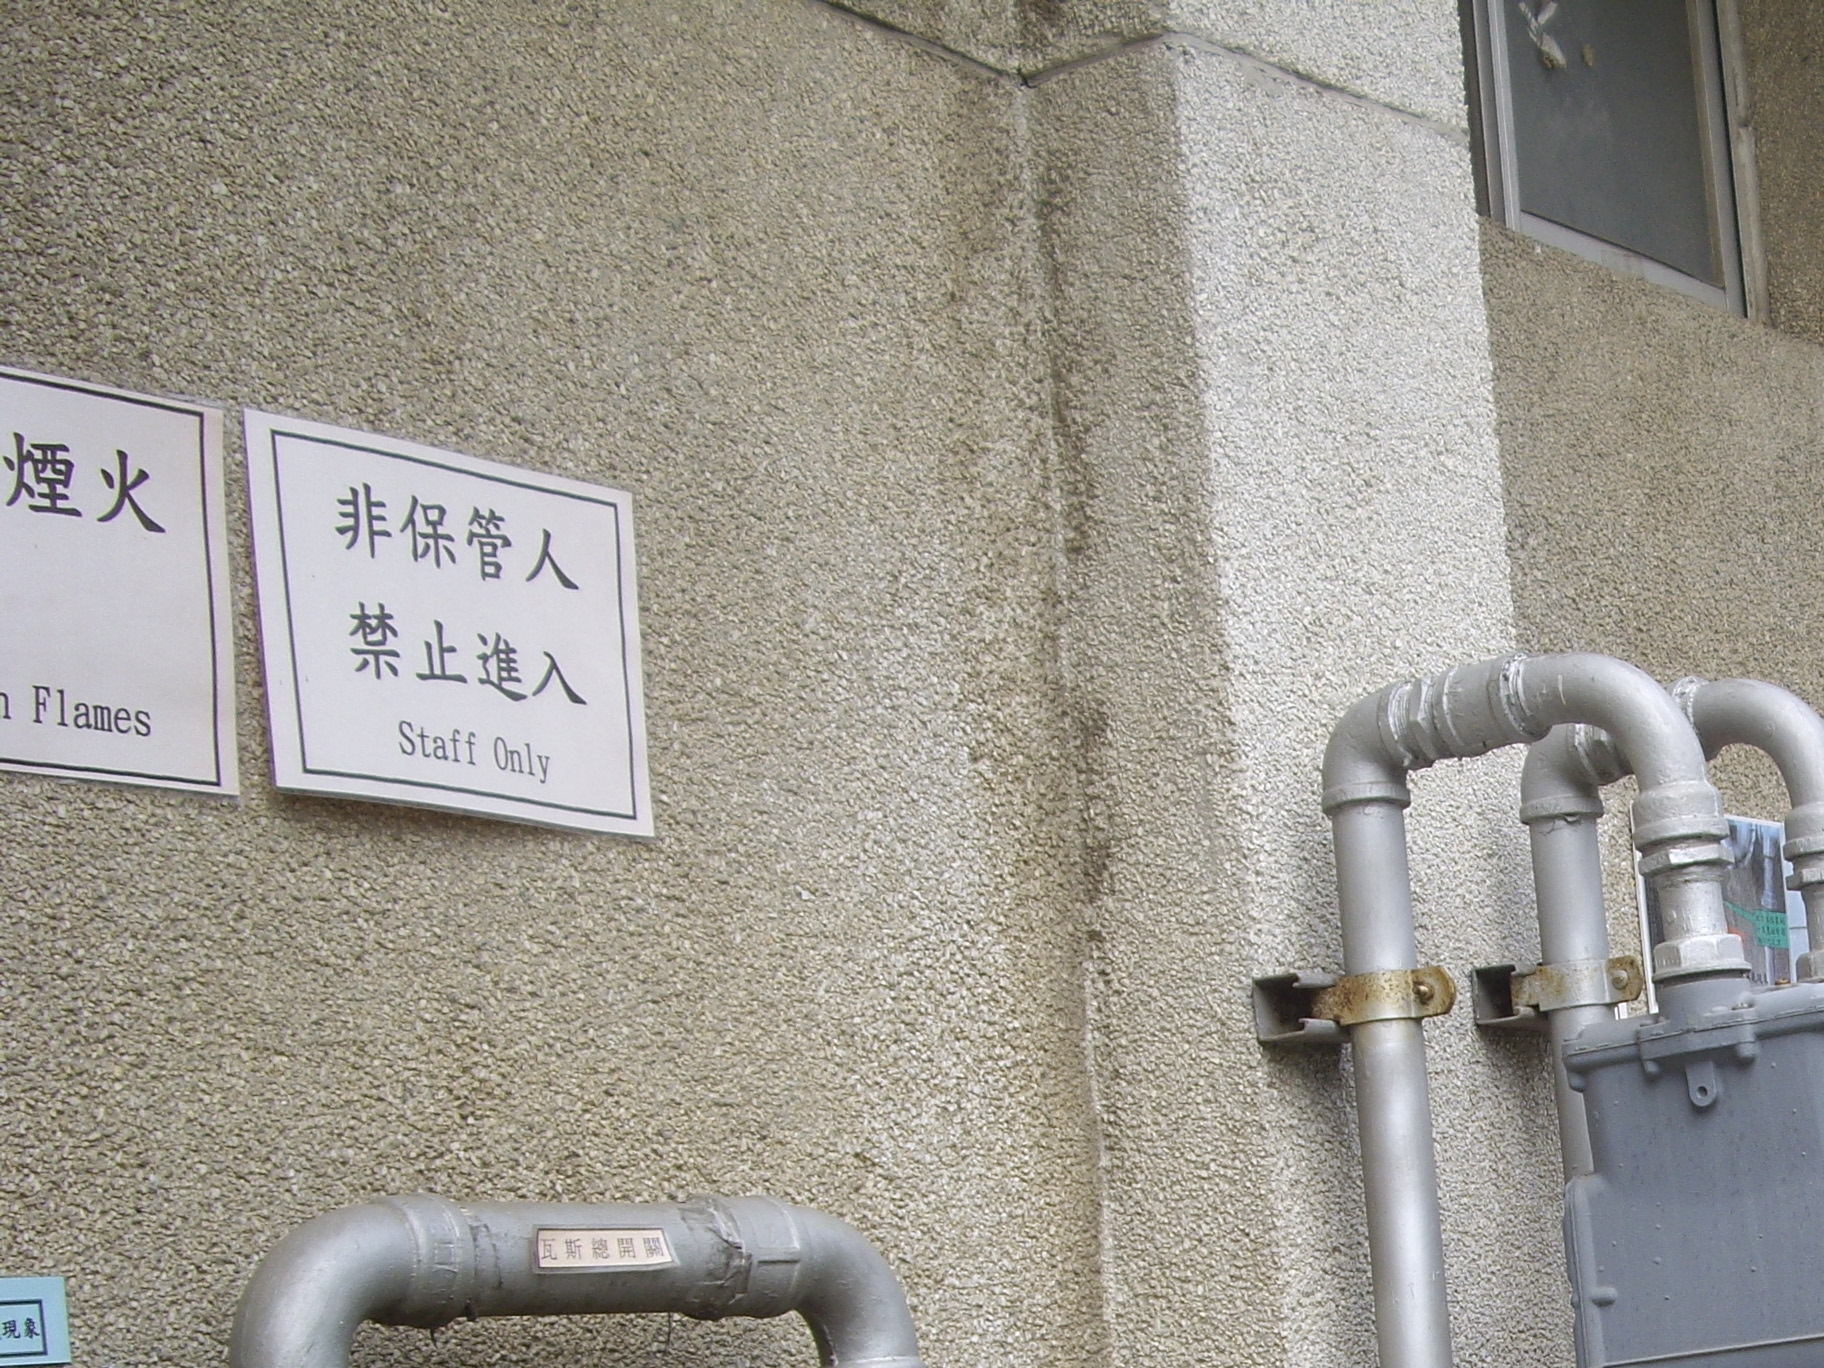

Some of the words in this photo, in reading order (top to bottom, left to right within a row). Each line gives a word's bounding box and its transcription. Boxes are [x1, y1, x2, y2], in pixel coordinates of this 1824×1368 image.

[3, 431, 166, 535] 煙火
[335, 482, 580, 592] 非保管人
[347, 602, 588, 707] 禁止進入
[32, 684, 151, 737] Flames
[398, 720, 476, 766] Staff
[493, 736, 550, 784] Only
[540, 1237, 665, 1261] 瓦斯總開關
[0, 1317, 41, 1340] 現象
